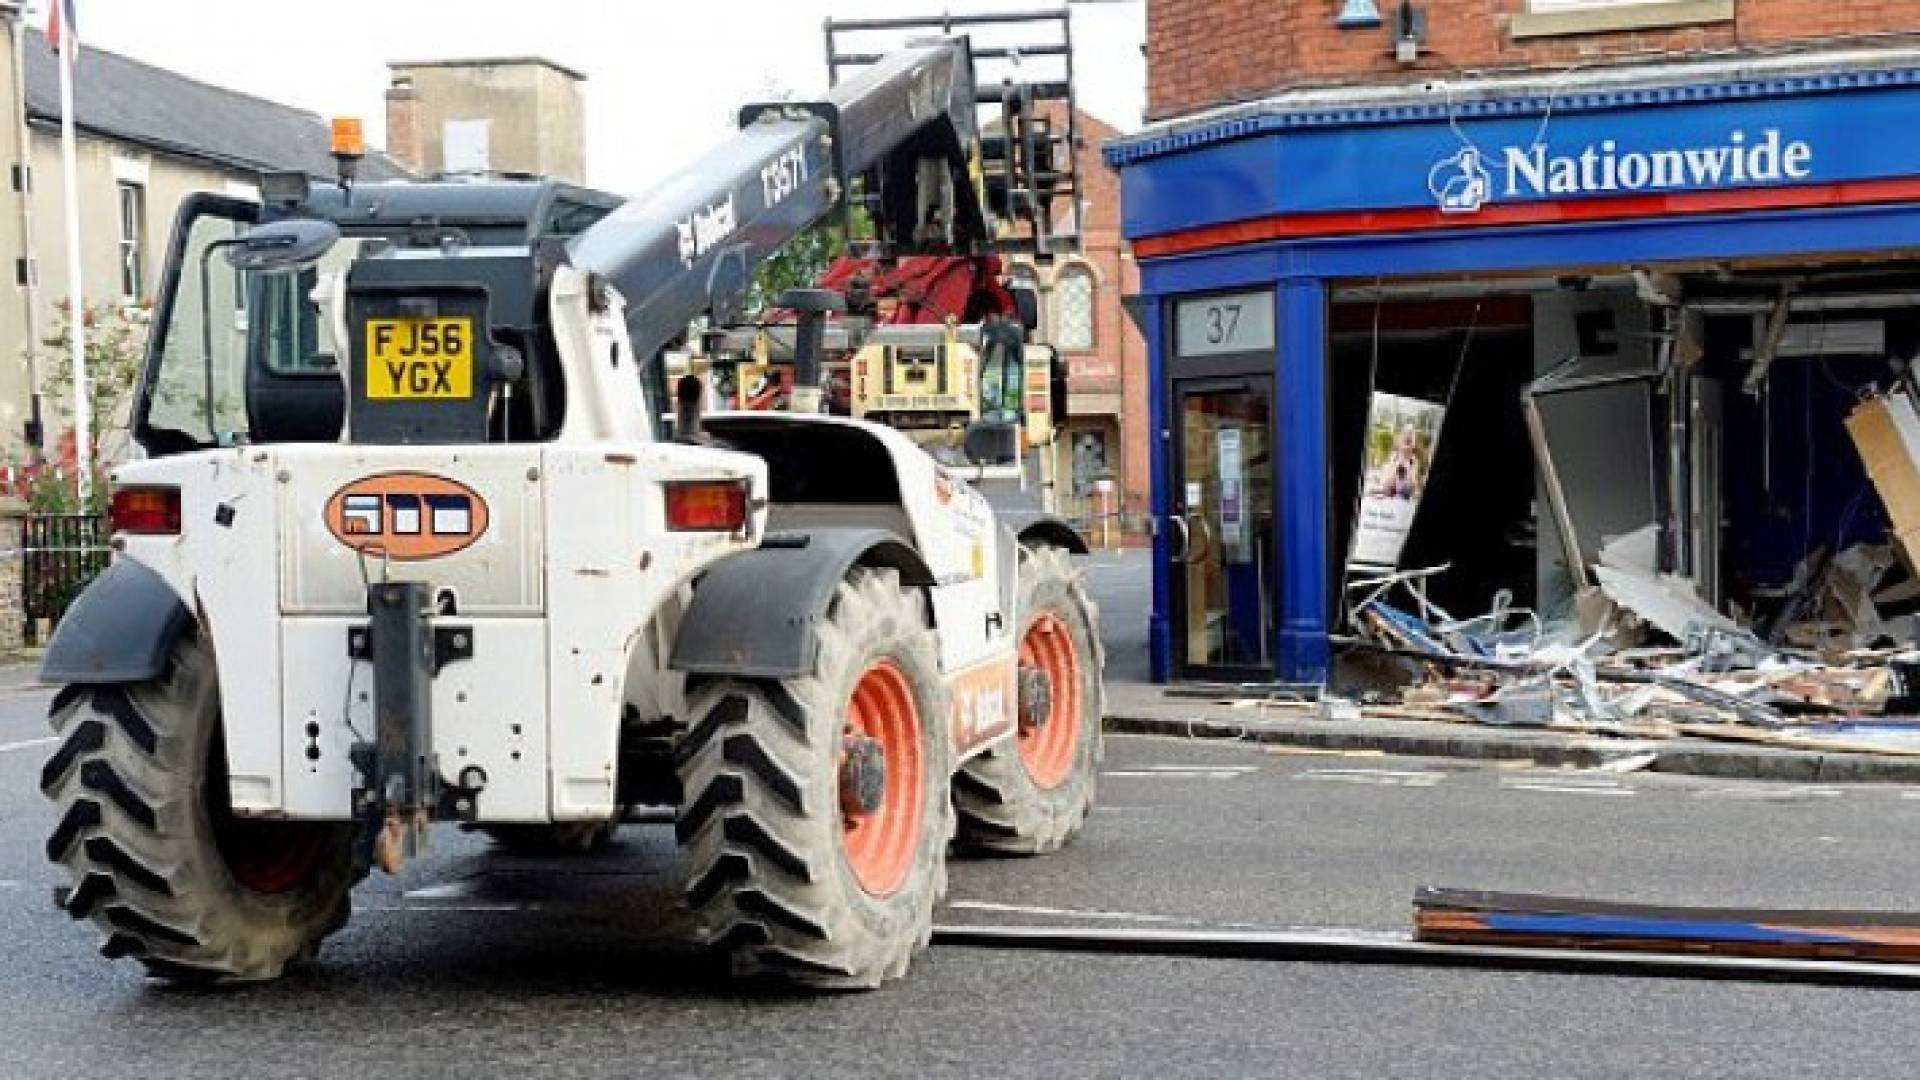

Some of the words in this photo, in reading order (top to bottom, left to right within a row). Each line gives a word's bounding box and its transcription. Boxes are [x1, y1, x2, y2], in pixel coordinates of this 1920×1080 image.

[1503, 129, 1811, 195] Nationwide
[375, 323, 462, 356] FJ56
[1206, 304, 1242, 344] 37
[386, 361, 452, 393] YGX
